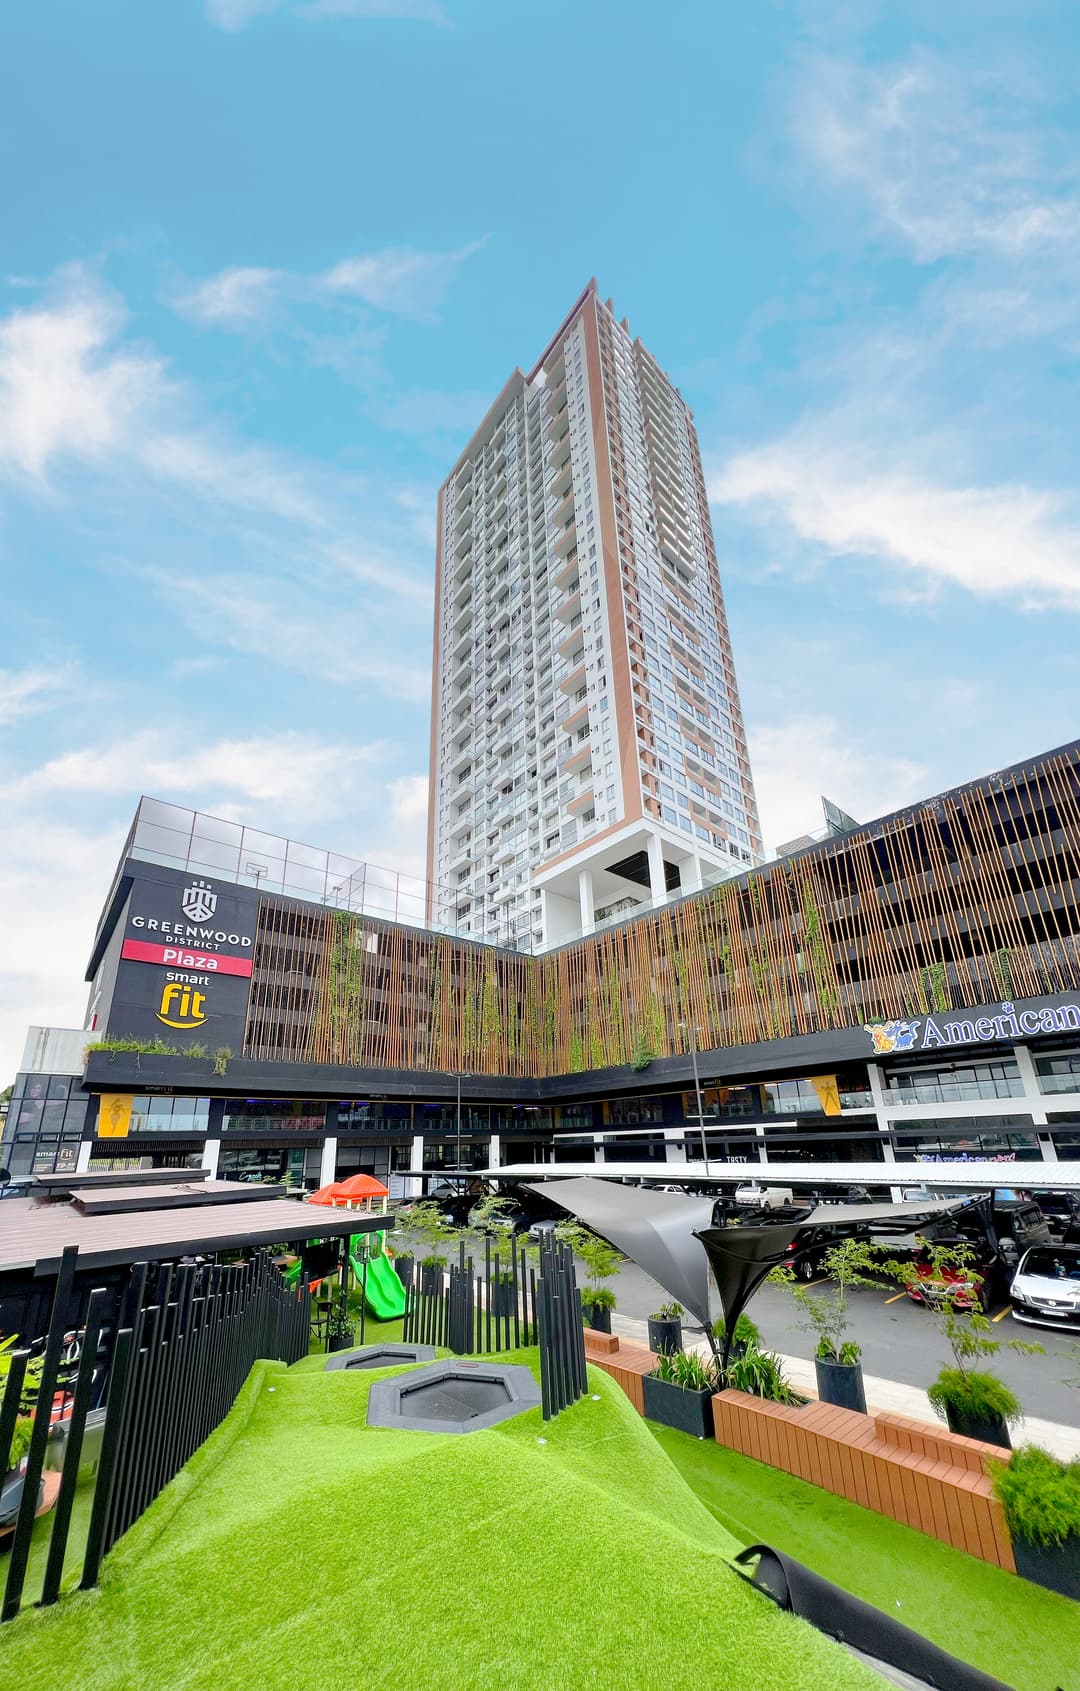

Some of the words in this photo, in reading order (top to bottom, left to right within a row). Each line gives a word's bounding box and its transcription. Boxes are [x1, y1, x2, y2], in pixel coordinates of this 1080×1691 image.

[131, 916, 252, 947] GREENWOOD
[165, 935, 221, 951] DISTRICT
[162, 949, 218, 970] Plaza
[166, 971, 210, 986] smart
[160, 983, 206, 1019] fit
[921, 1001, 1080, 1049] American
[726, 1156, 748, 1164] TASTY
